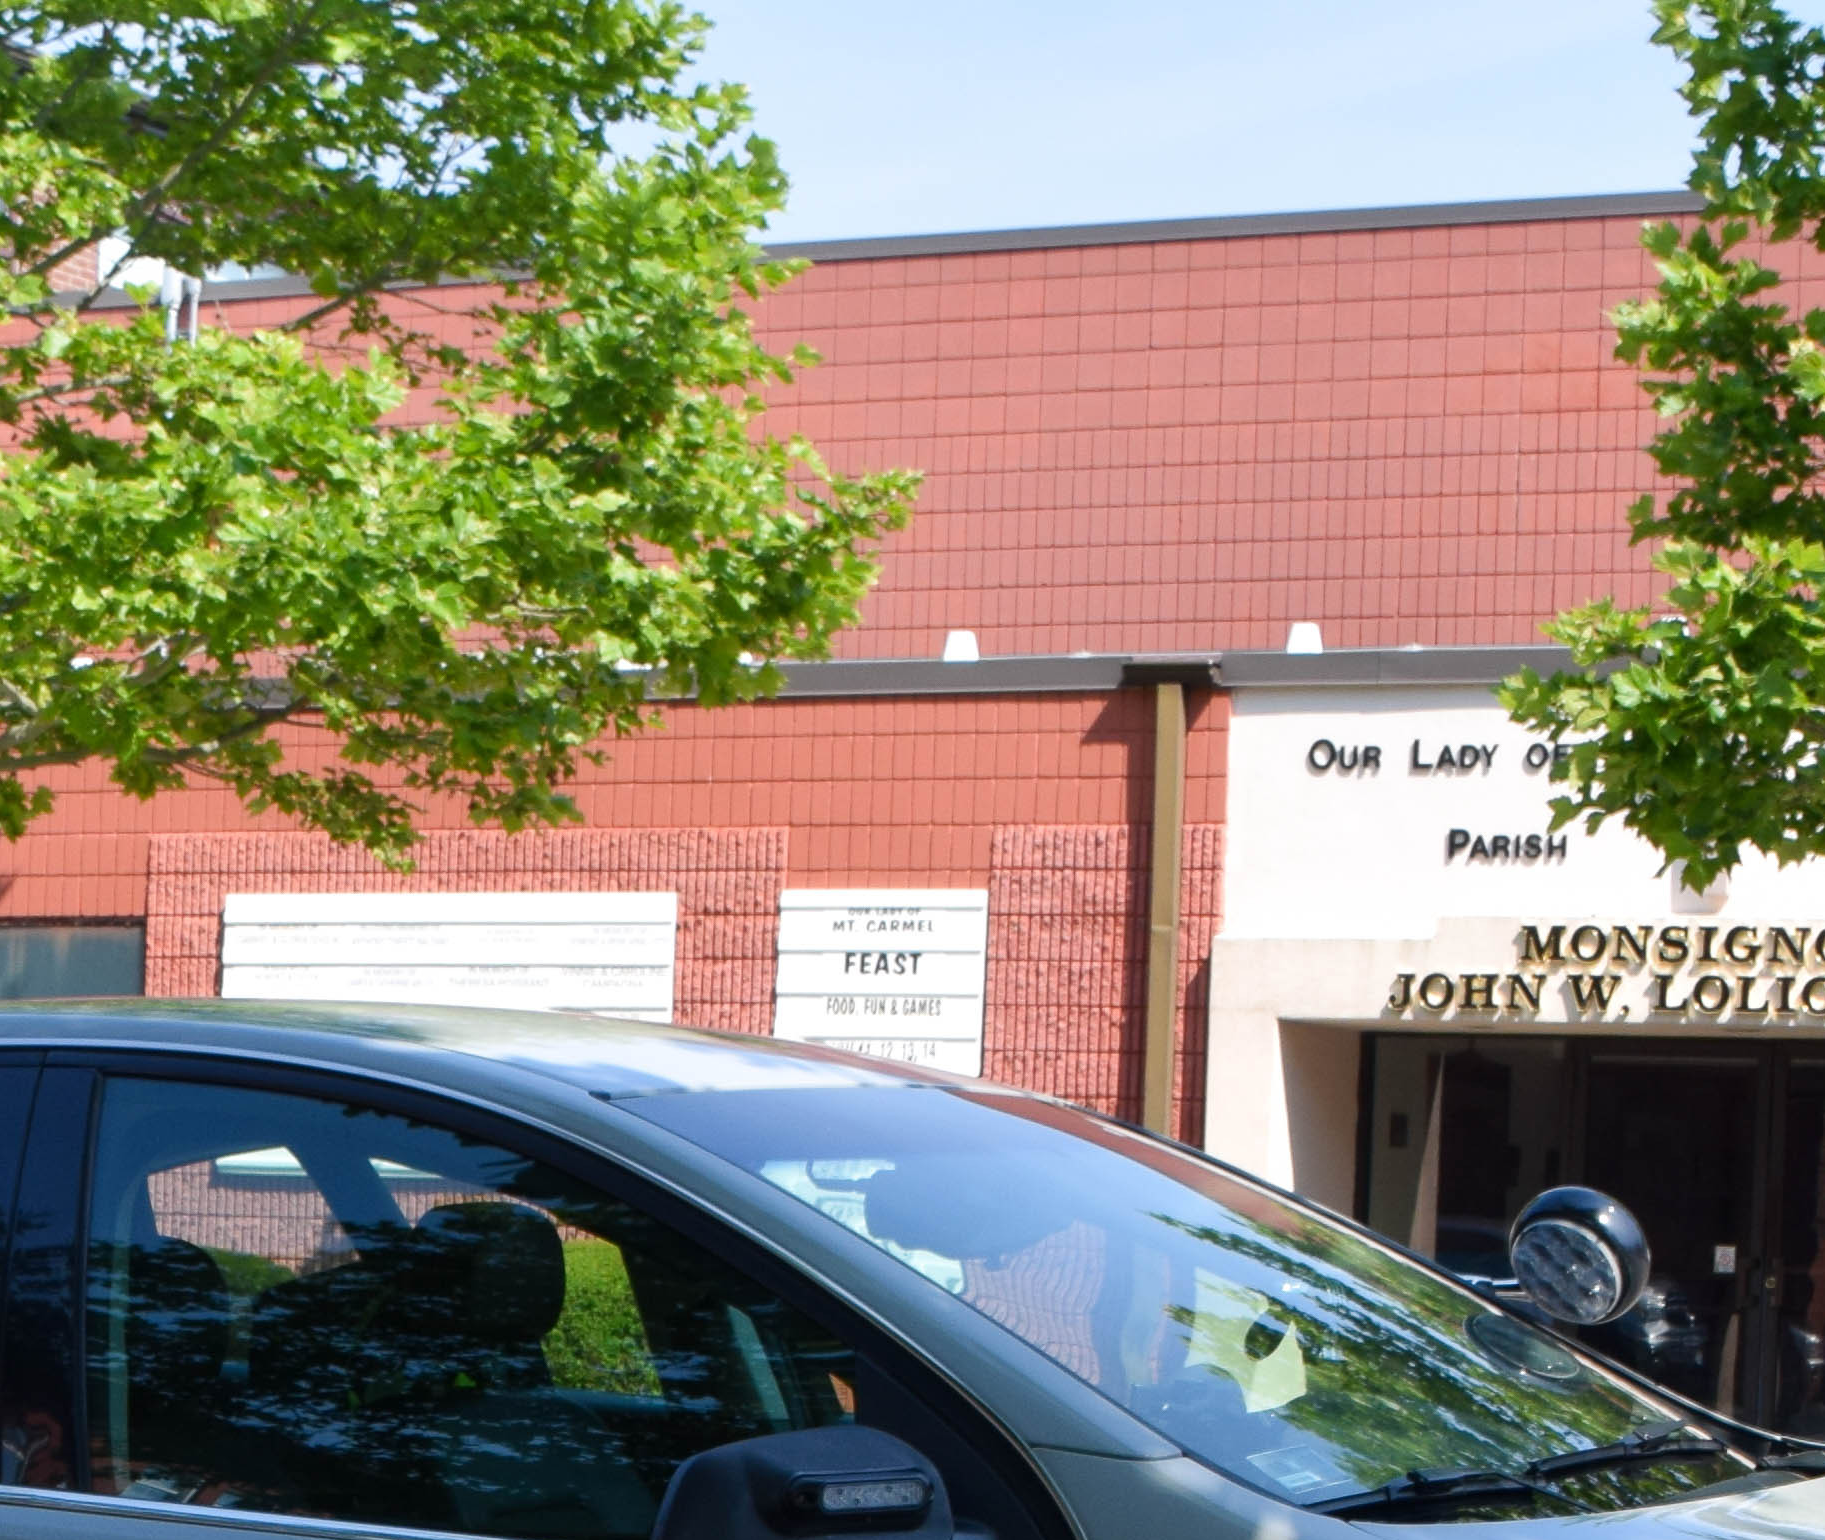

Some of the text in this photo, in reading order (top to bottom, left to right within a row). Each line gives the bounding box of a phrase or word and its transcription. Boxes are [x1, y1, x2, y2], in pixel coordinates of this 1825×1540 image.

[1411, 739, 1499, 772] LADY
[1447, 828, 1568, 862] PARISH
[866, 920, 935, 932] CARMEL
[844, 952, 923, 975] FEAST
[864, 998, 886, 1015] FUN
[890, 999, 898, 1015] &
[902, 999, 942, 1017] GAMES
[1390, 973, 1547, 1015] JOHN
